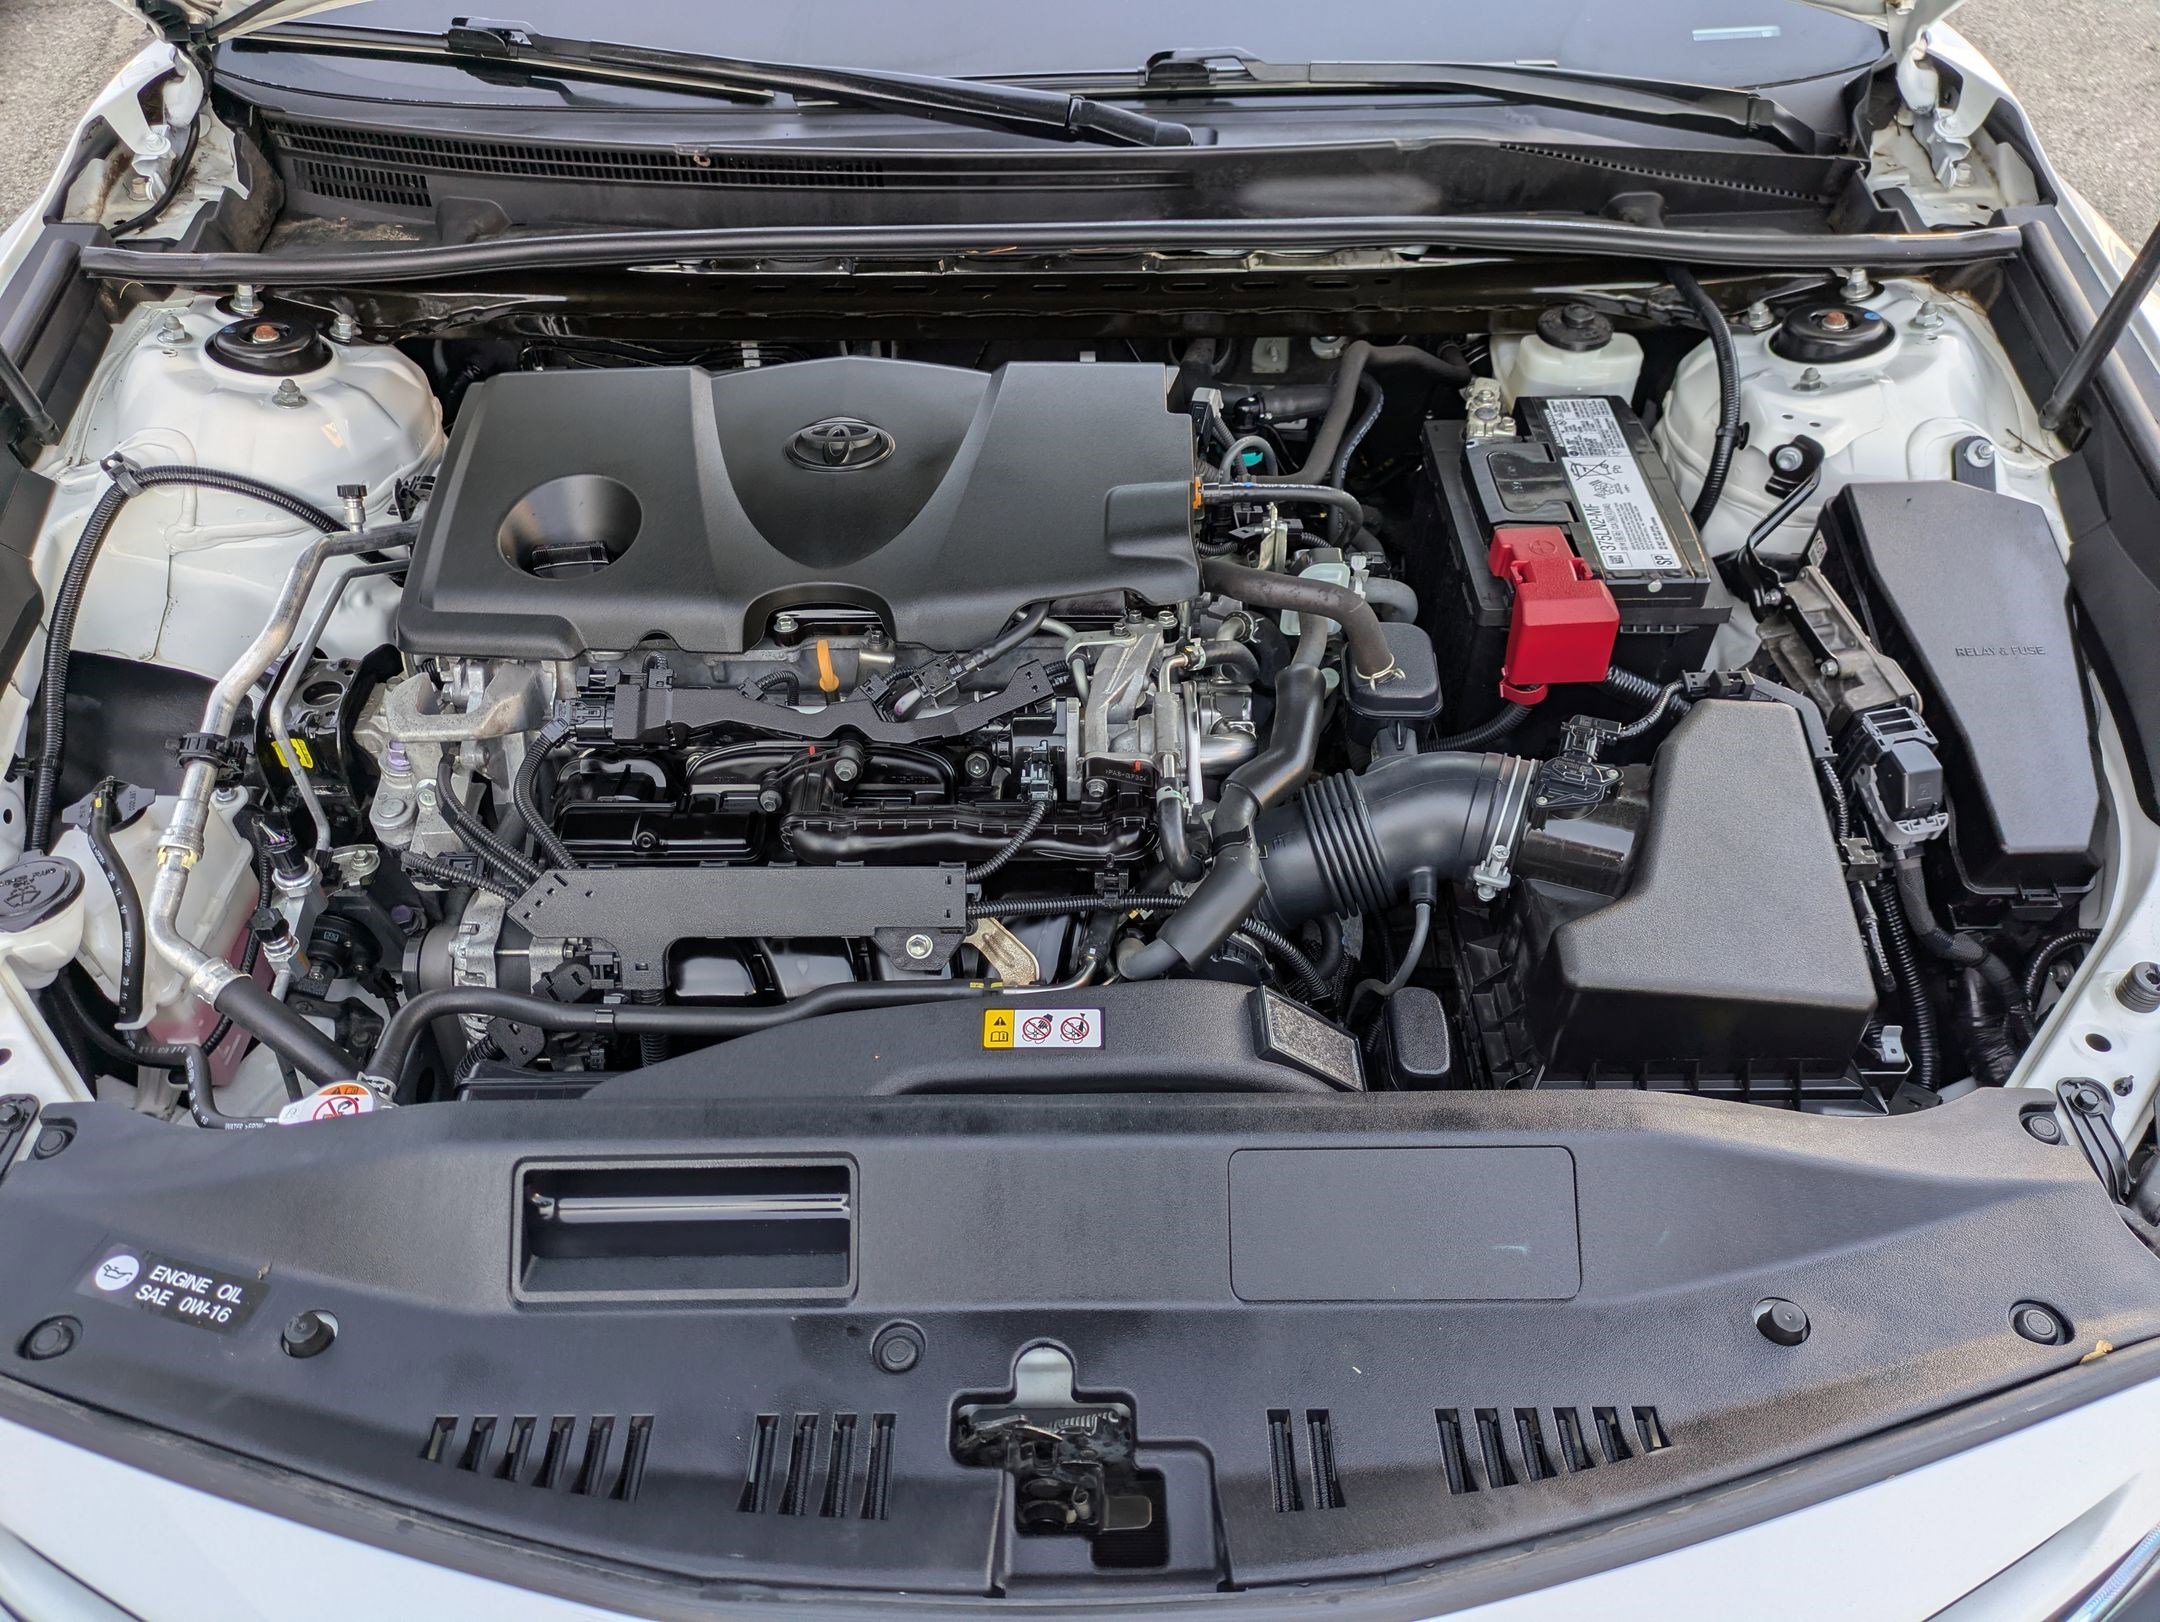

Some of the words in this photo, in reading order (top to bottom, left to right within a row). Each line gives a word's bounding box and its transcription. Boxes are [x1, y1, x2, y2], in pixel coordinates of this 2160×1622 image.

[1582, 503, 1617, 551] 375LN2-MF
[1654, 555, 1674, 567] SP
[1955, 647, 1996, 657] RELAY
[1999, 647, 2010, 656] &
[2010, 645, 2047, 656] FUSE
[135, 1284, 174, 1307] SAE
[178, 1296, 232, 1323] 0W-16
[149, 1264, 213, 1294] ENGINE
[216, 1283, 243, 1305] OIL
